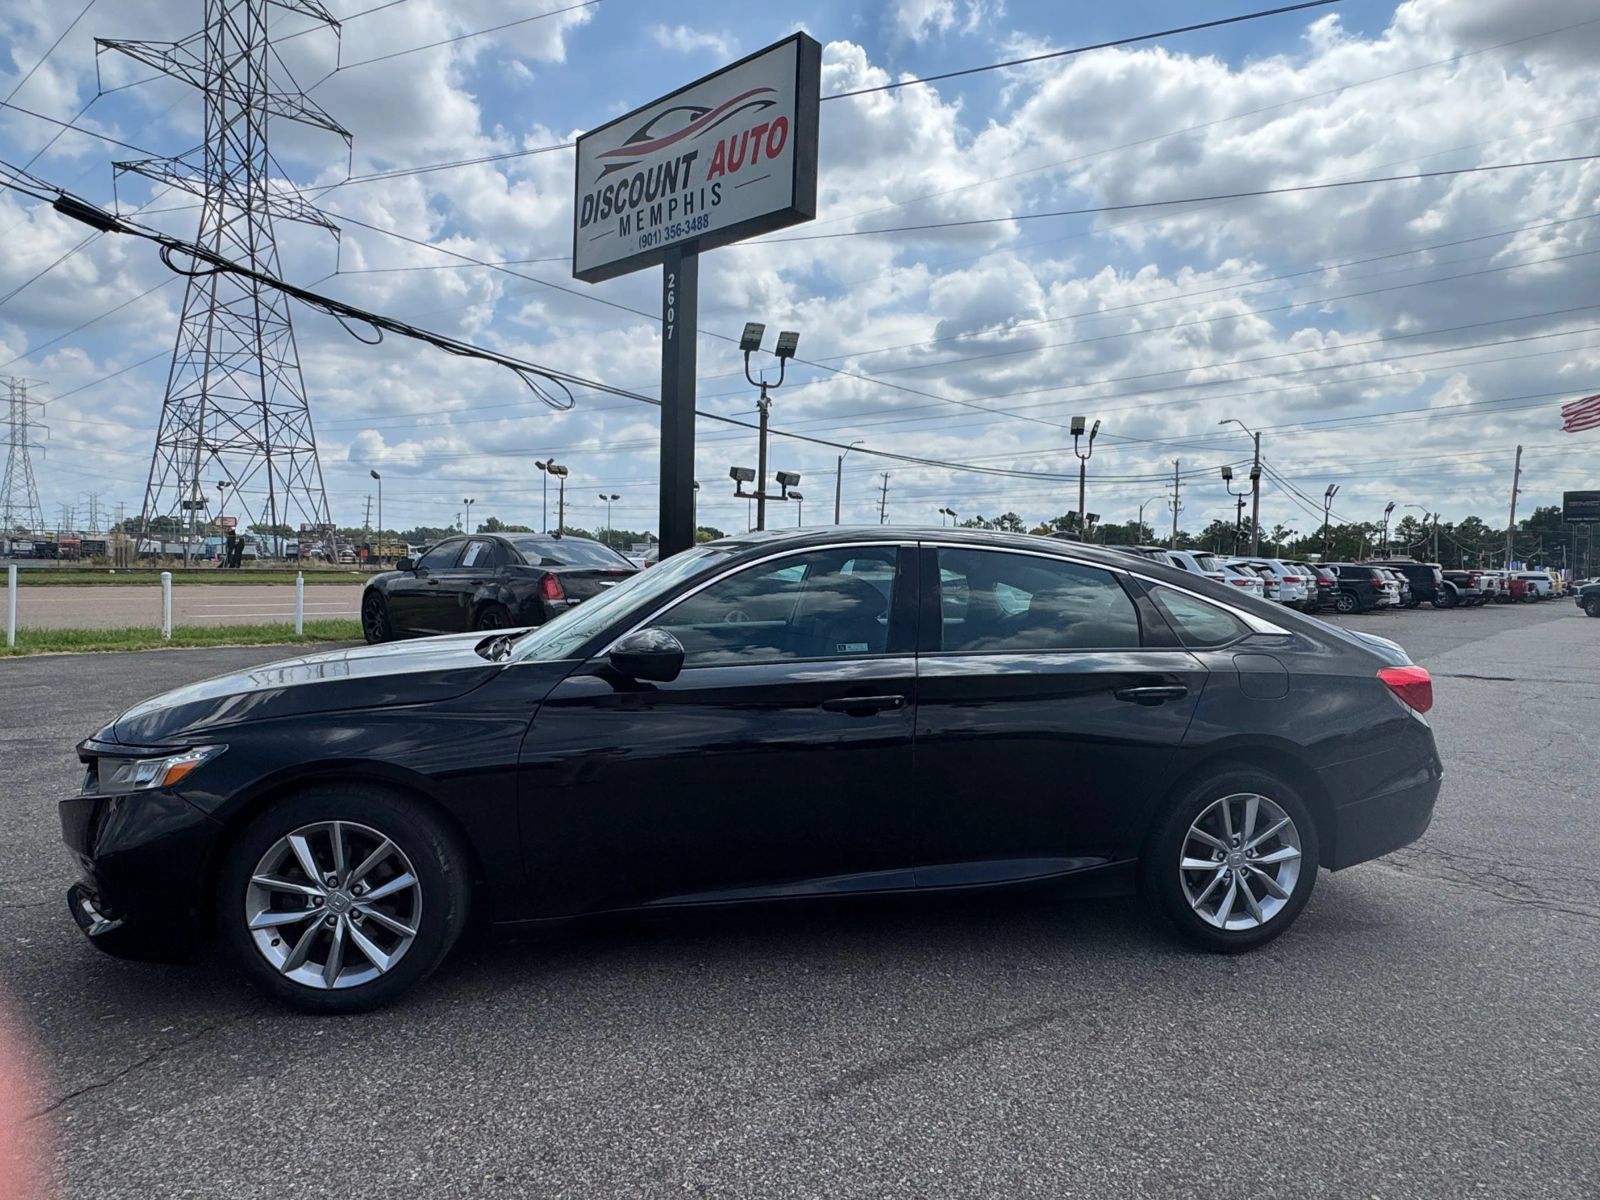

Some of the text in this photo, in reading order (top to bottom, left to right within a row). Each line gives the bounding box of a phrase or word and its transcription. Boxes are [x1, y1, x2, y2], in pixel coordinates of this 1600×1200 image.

[580, 116, 789, 228] DISCOUNT AUTO
[619, 182, 722, 237] MEMPHIS
[639, 214, 709, 249] (901) 356-3488
[667, 273, 675, 339] 2607
